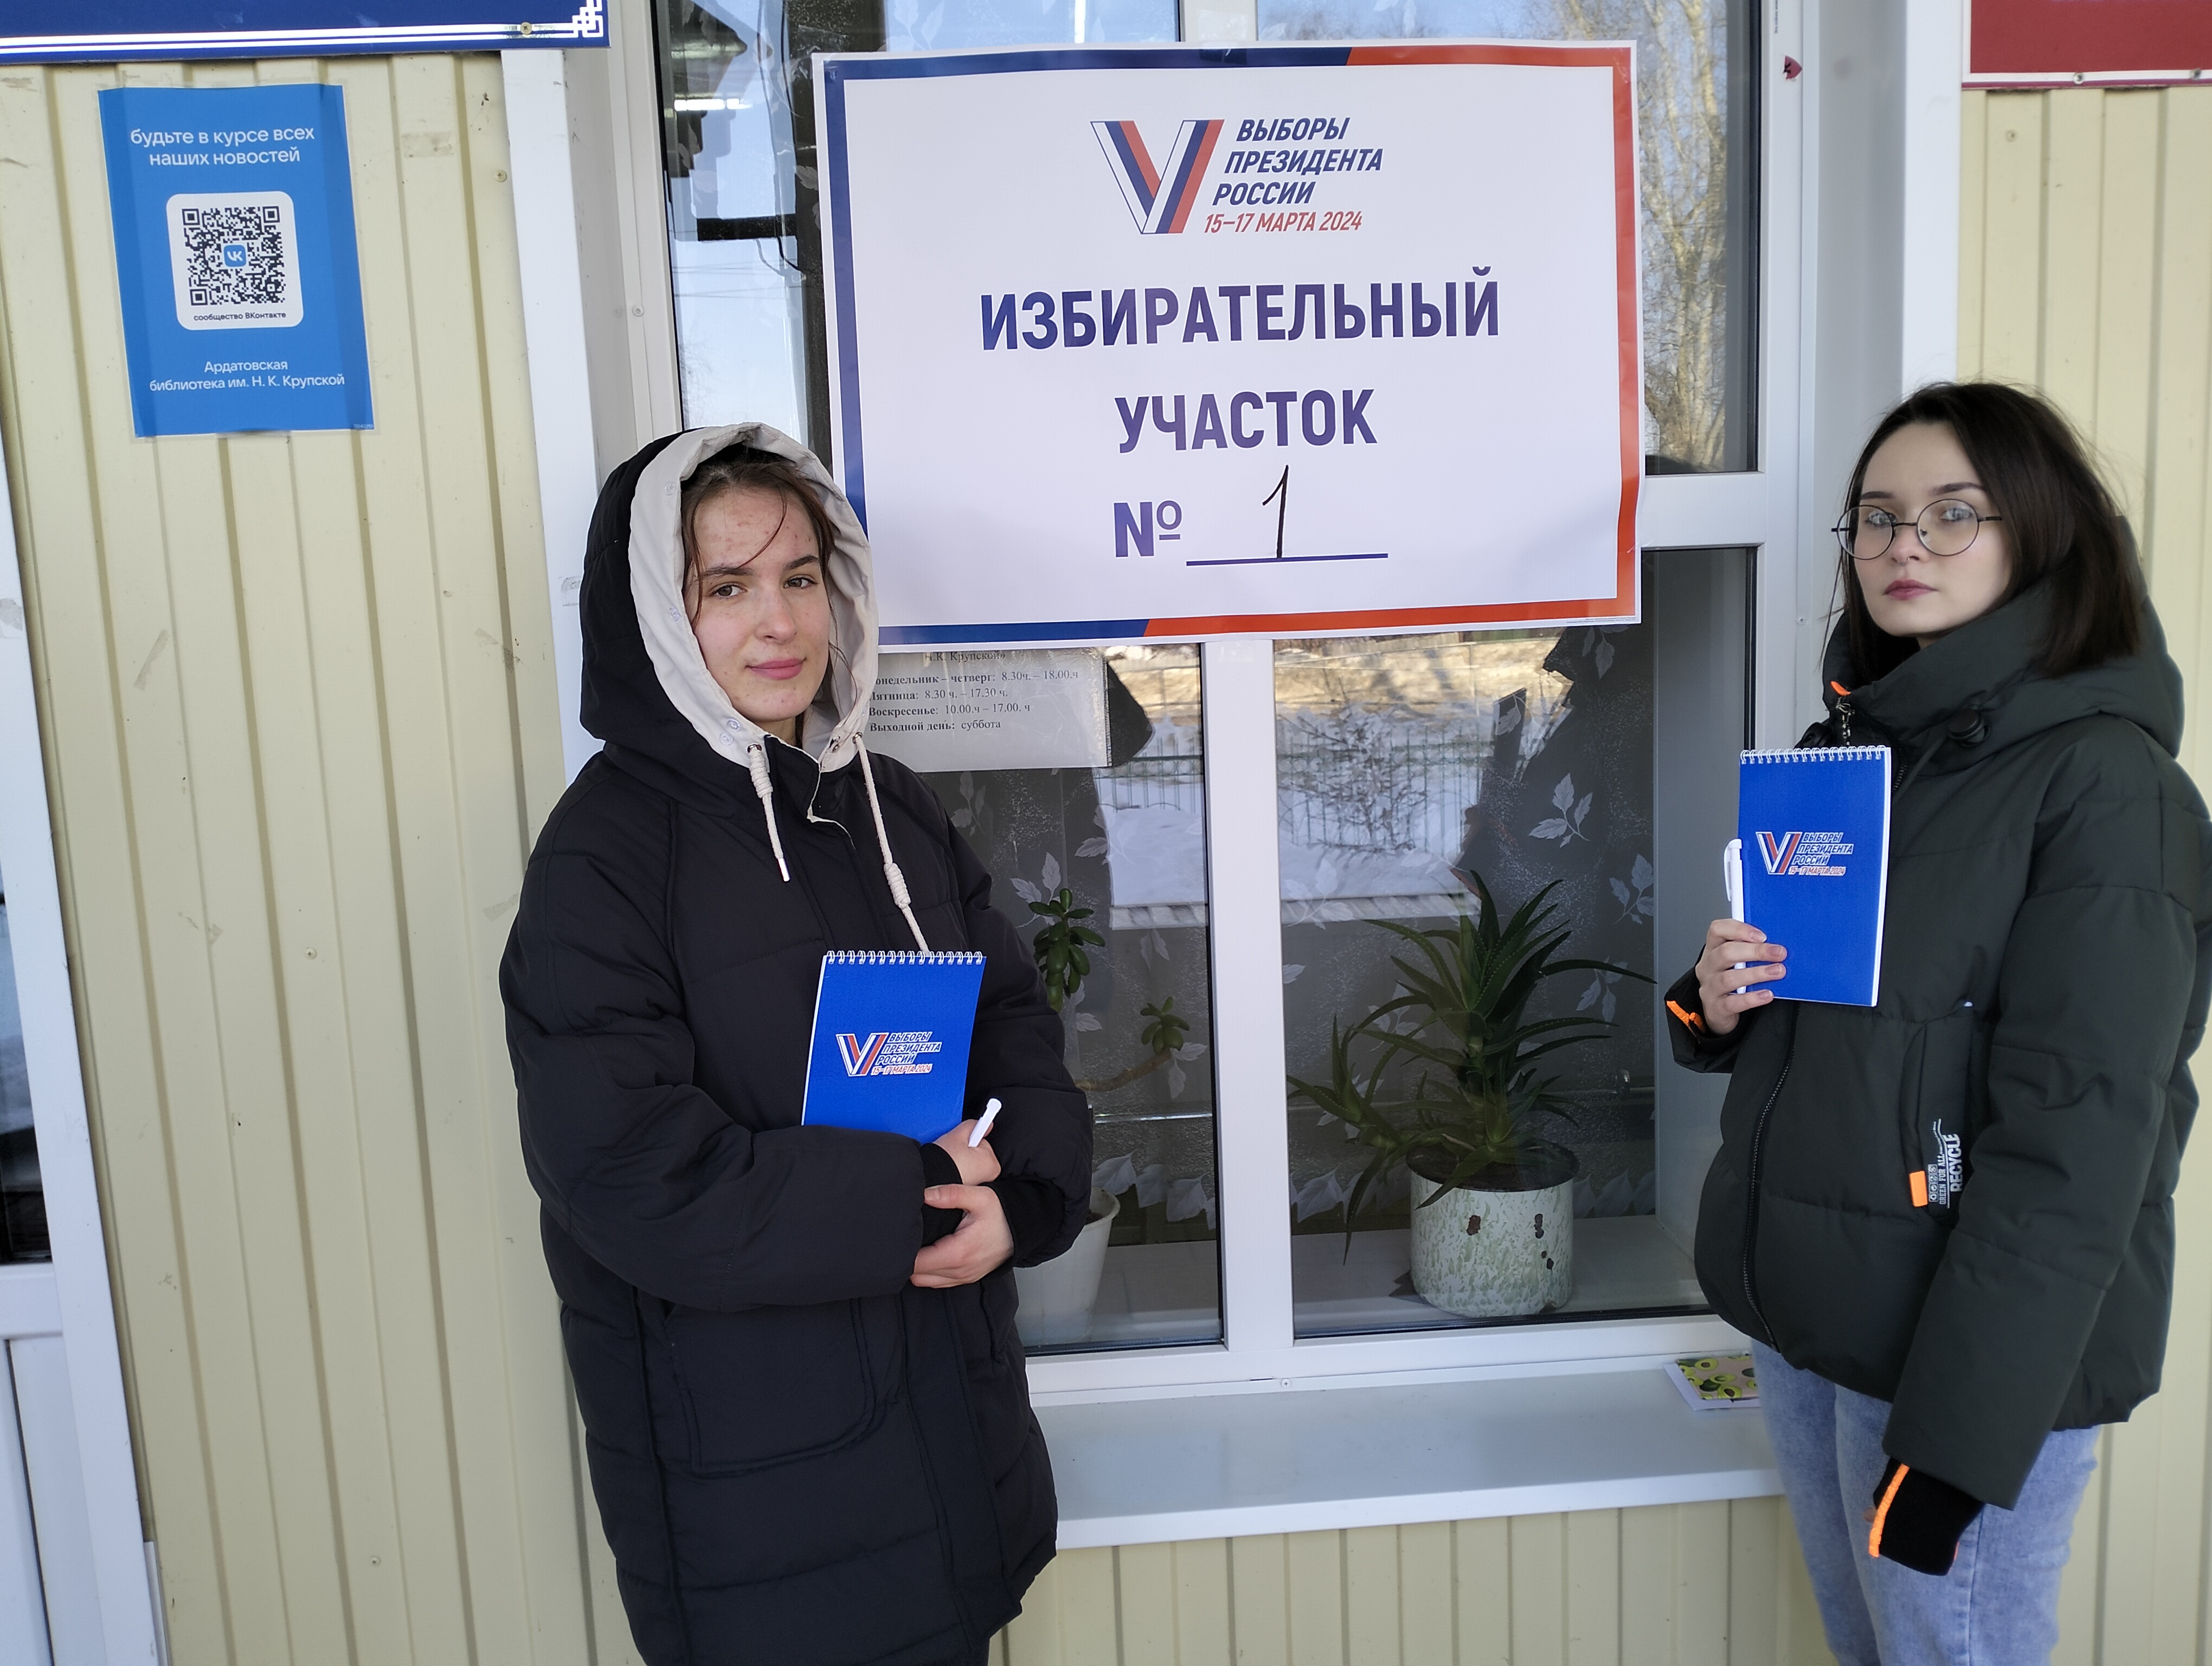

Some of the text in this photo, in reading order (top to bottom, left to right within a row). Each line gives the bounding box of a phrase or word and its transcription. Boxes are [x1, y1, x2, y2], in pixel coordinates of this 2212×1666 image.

[1236, 117, 1351, 142] ВЫБОРЫ
[131, 128, 315, 148] будьте в курсе всех
[149, 146, 301, 166] наших новостей
[1224, 148, 1384, 176] ПРЕЗИДЕНТА
[1212, 181, 1316, 206] РОССИИ
[1255, 212, 1316, 232] МАРТА
[1318, 210, 1362, 231] 2024
[980, 266, 1499, 350] ИЗБИРАТЕЛЬНЫЙ
[193, 313, 243, 322] сообщество
[204, 361, 288, 374] Ардатовская
[149, 373, 345, 392] библиотека им. Н. К. Крупской
[1114, 388, 1378, 454] УЧАСТОК
[1262, 465, 1289, 558] 1
[876, 676, 939, 685] онедельник
[950, 674, 995, 684] четверг:
[924, 689, 946, 699] 8.30
[869, 707, 938, 718] Воскресенье:
[870, 720, 1001, 732] Выходной день: суббота
[1803, 832, 1842, 842] ВЫБОРЫ
[1798, 844, 1853, 854] ПРЕЗИДЕНТА
[1793, 855, 1829, 865] РОССИИ
[1808, 867, 1830, 875] МАРТА
[1830, 867, 1846, 875] 2024
[888, 1032, 932, 1042] ВЫБОРЫ
[883, 1042, 942, 1054] ПРЕЗИДЕНТА
[876, 1054, 916, 1065] РОССИИ
[893, 1065, 915, 1074] МАРТА
[915, 1064, 932, 1073] 2024
[1937, 1154, 1946, 1167] ALL
[1943, 1133, 1963, 1192] RECYCLE
[1939, 1183, 1947, 1205] GREEN
